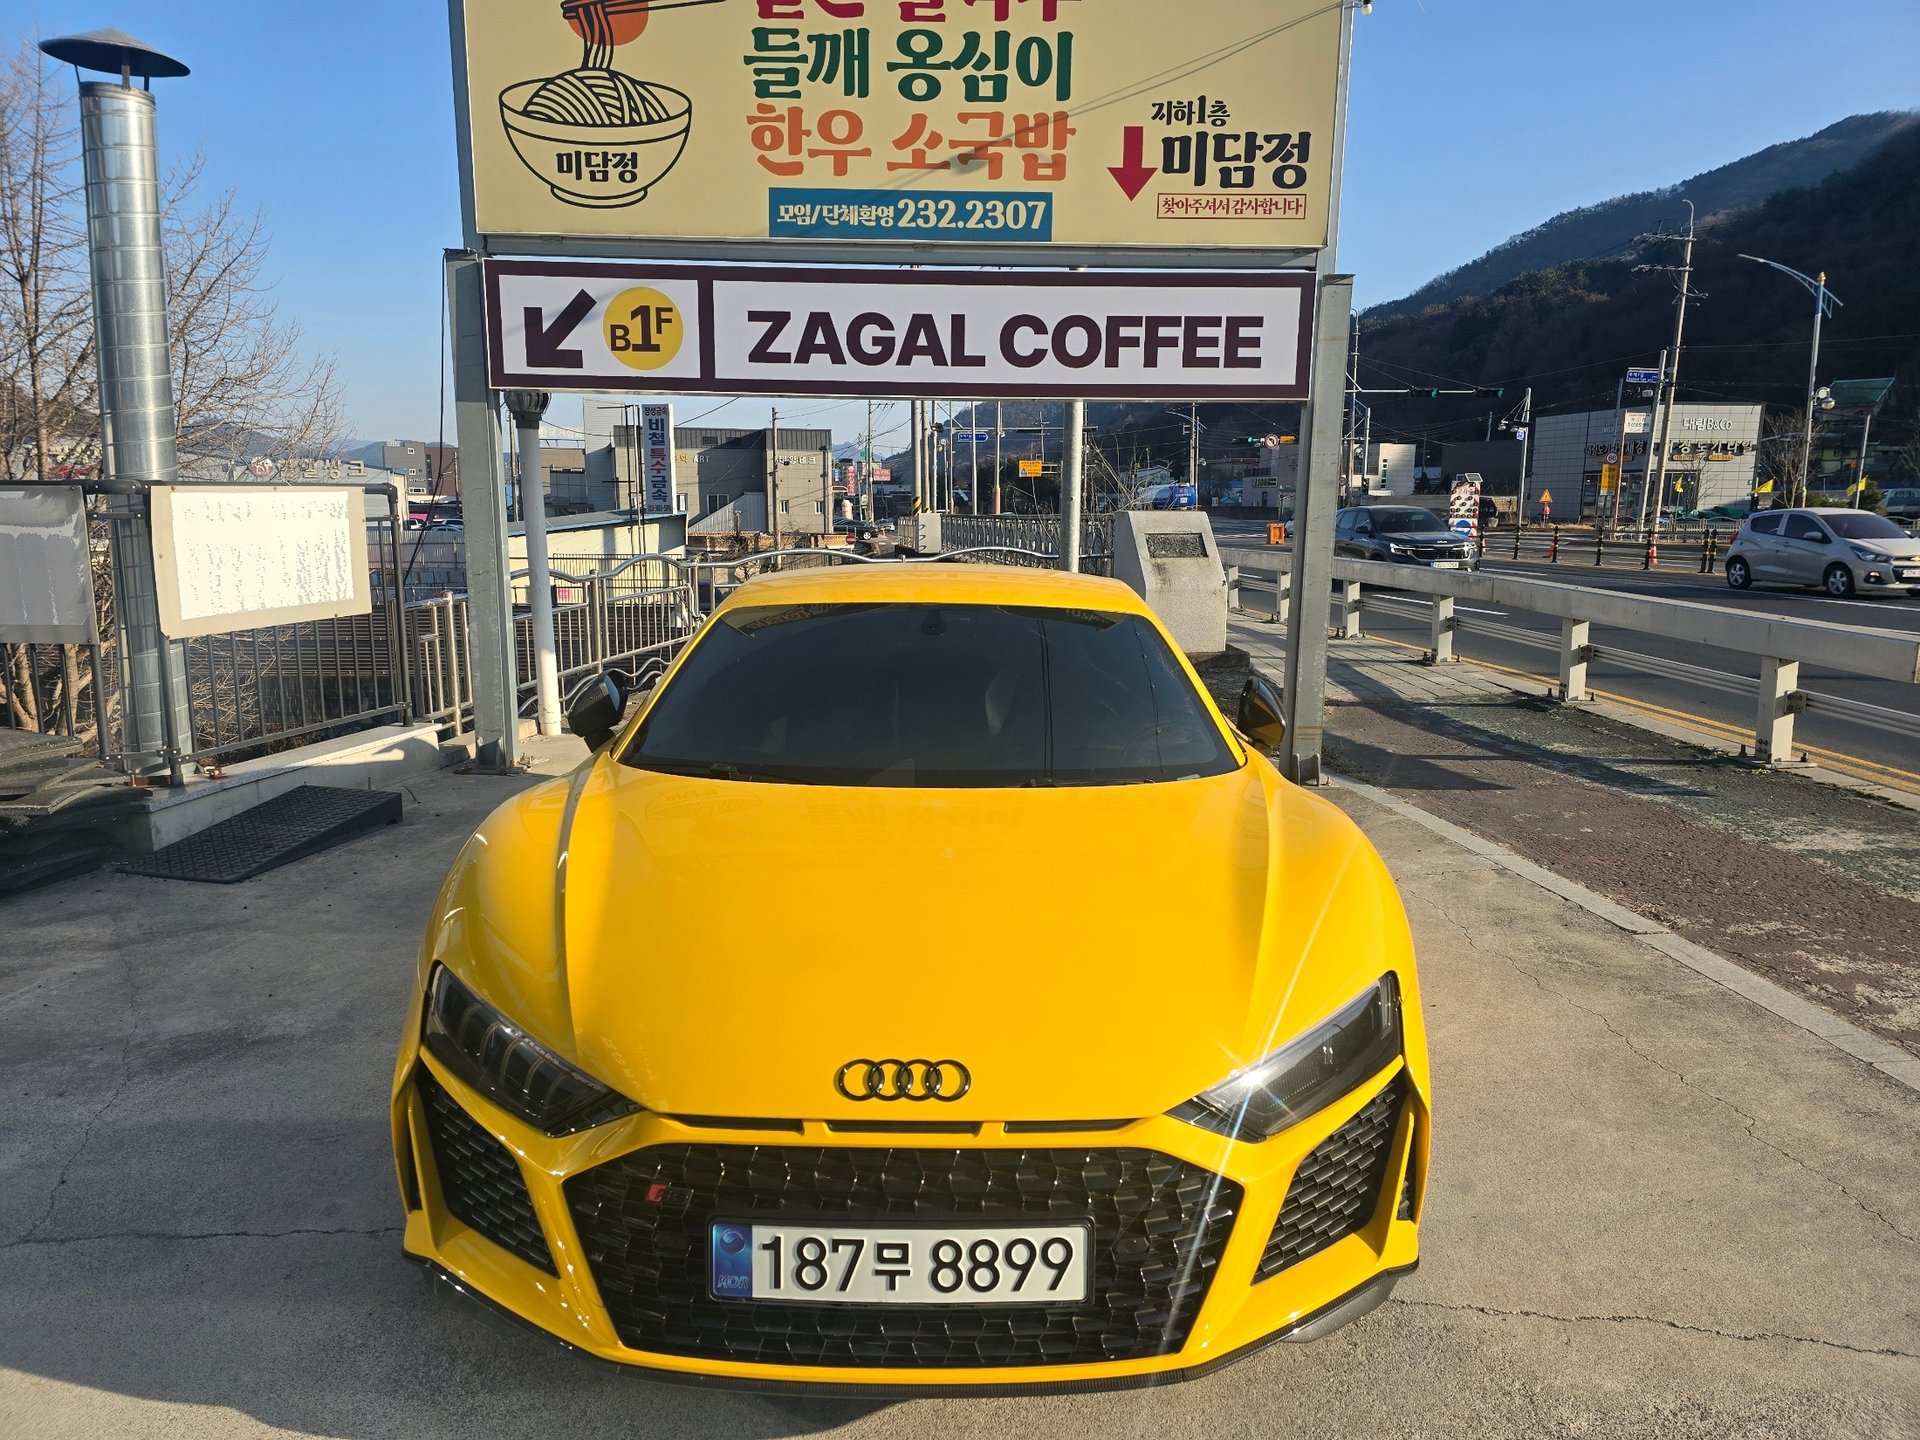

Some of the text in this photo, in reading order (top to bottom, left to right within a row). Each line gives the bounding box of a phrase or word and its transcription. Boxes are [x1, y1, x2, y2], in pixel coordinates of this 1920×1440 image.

[743, 27, 1073, 102] 들깨 옹심이
[1151, 95, 1231, 127] 지하1층
[556, 151, 638, 183] 미담정
[746, 103, 1077, 181] 한우 소국밥
[1161, 131, 1312, 189] 미담정
[897, 199, 1047, 230] 232.2307
[610, 305, 673, 352] B1F
[747, 310, 1264, 369] ZAGAL COFFEE
[931, 1236, 1074, 1294] 8899
